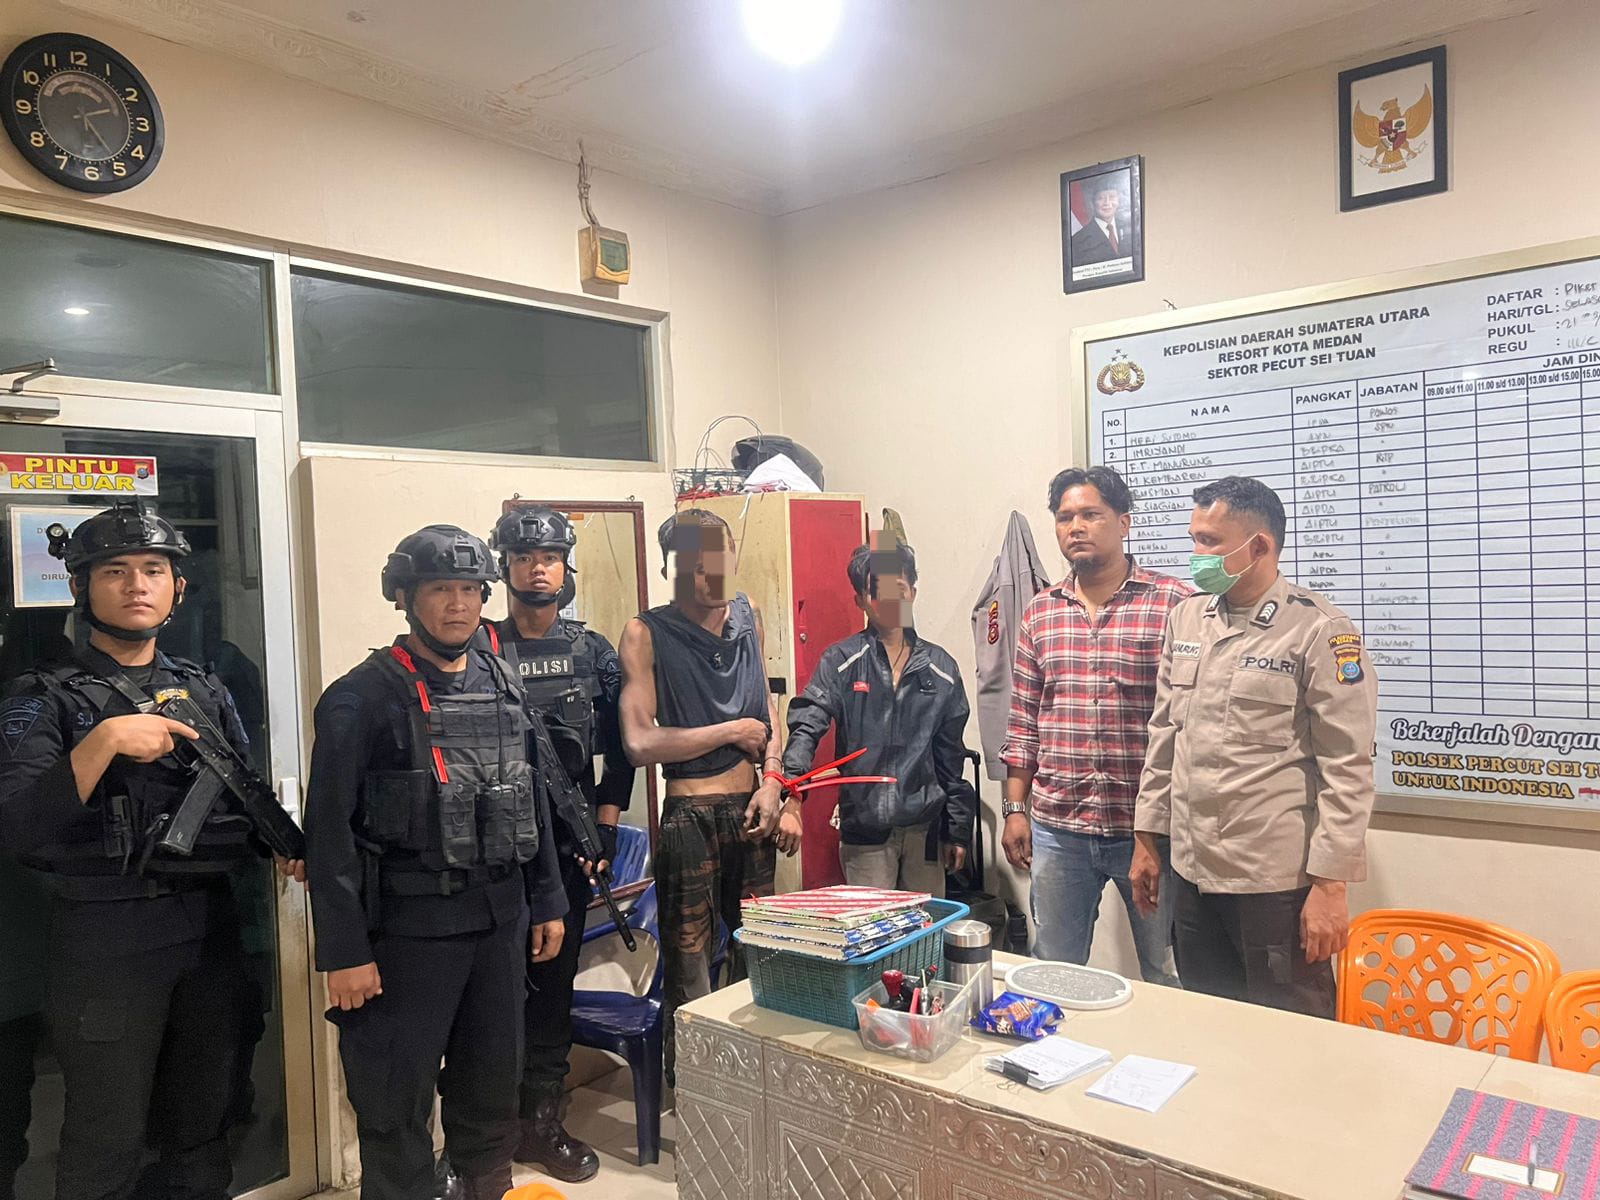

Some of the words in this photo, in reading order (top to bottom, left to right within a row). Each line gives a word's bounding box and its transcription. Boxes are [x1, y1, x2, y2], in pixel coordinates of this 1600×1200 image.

[43, 52, 56, 67] 11
[70, 51, 88, 66] 12
[105, 63, 111, 76] 1
[23, 70, 39, 85] 10
[125, 88, 138, 102] 2
[15, 99, 32, 114] 9
[136, 117, 150, 132] 3
[30, 131, 45, 148] 8
[131, 144, 145, 160] 4
[54, 154, 69, 170] 7
[113, 161, 127, 176] 5
[84, 166, 100, 181] 6
[1487, 288, 1543, 306] DAFTAR
[1163, 336, 1237, 357] KEPOLISIAN
[1241, 327, 1294, 345] DAERAH
[1298, 315, 1375, 336] SUMATERA
[1379, 306, 1430, 324] UTARA
[1488, 323, 1536, 338] PUKUL
[1218, 347, 1269, 363] RESORT
[1273, 341, 1308, 356] KOTA
[1313, 333, 1363, 350] MEDAN
[1488, 340, 1528, 355] REGU
[1208, 363, 1258, 380] SEKTOR
[1262, 357, 1306, 372] PECUT
[1310, 352, 1332, 366] SEI
[1335, 347, 1376, 363] TUAN
[1543, 356, 1574, 368] JAM
[1477, 380, 1494, 391] 11.00
[1508, 377, 1525, 388] 13.00
[1529, 374, 1547, 385] 13.00
[1549, 372, 1560, 383] s/d
[1561, 370, 1580, 381] 15.00
[1360, 382, 1418, 397] JABATAN
[1457, 383, 1473, 393] 11.00
[1296, 390, 1352, 404] PANGKAT
[1107, 419, 1122, 428] NO.
[25, 457, 119, 474] PINTU
[10, 473, 136, 491] KELUAR
[519, 660, 569, 676] OLISI
[1245, 656, 1296, 674] POLRI
[1391, 718, 1510, 749] Bekerjalah
[1392, 751, 1464, 770] POLSEK
[1466, 755, 1545, 776] PERCUT
[1546, 759, 1582, 778] SEI
[1583, 762, 1600, 779] T
[1392, 771, 1461, 791] UNTUK
[1461, 776, 1575, 799] INDONESIA
